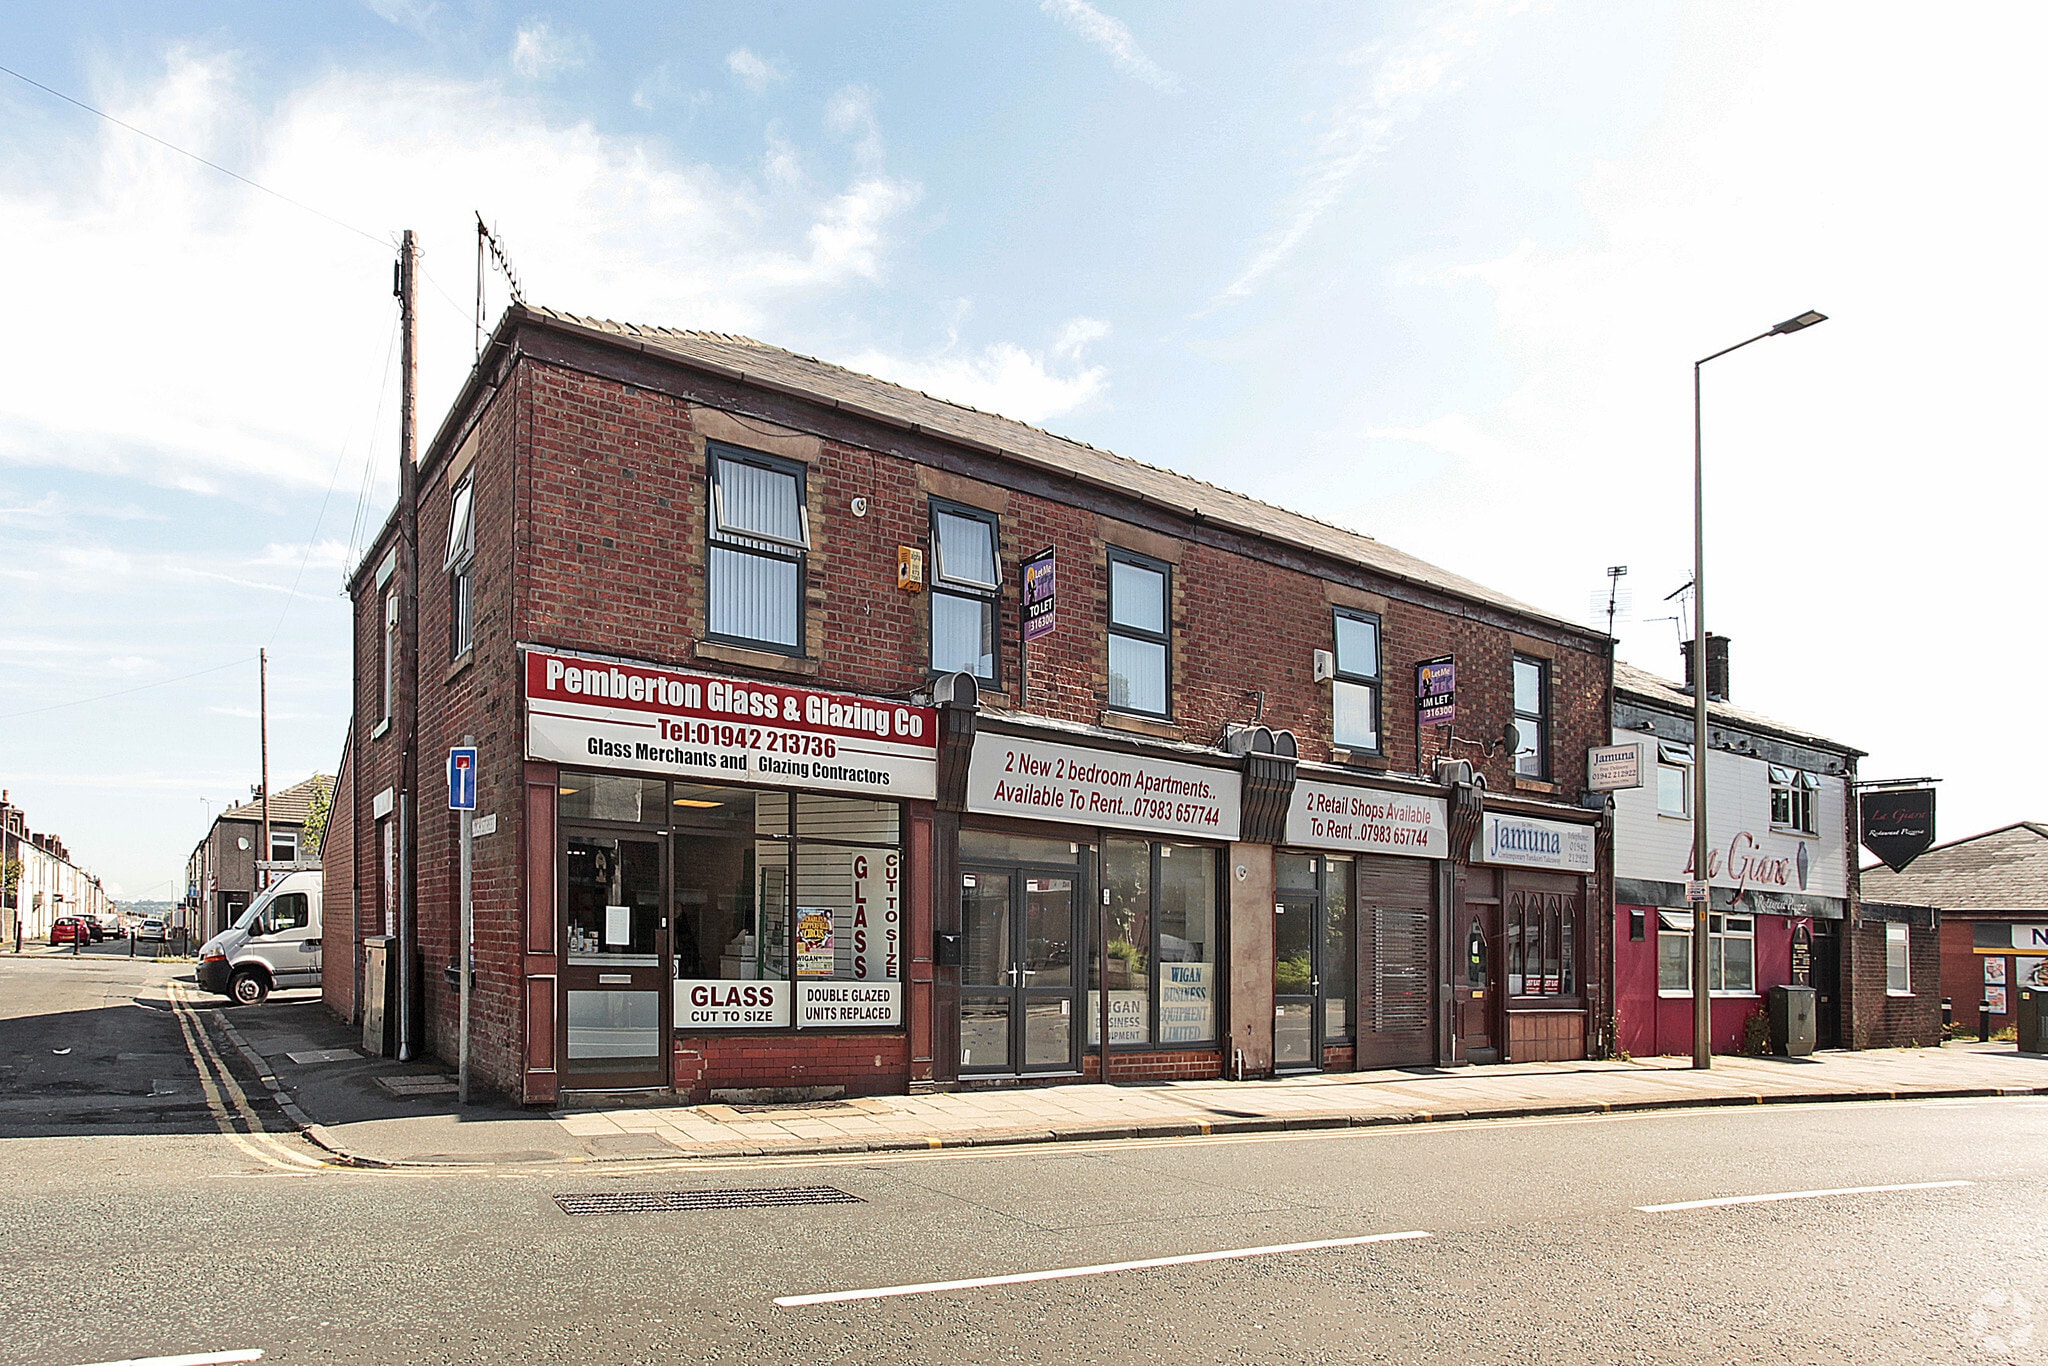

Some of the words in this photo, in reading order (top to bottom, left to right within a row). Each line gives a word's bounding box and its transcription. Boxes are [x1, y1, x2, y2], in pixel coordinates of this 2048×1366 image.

[1029, 604, 1039, 618] TO
[1040, 598, 1053, 613] LET
[1030, 614, 1053, 631] 316300
[546, 658, 702, 709] Pemberton
[707, 681, 778, 719] Glass
[783, 696, 801, 722] &
[805, 695, 890, 737] Glazing
[894, 708, 923, 738] Co
[1434, 694, 1449, 705] LET
[1426, 706, 1453, 718] 316300
[657, 718, 761, 750] Tel:01942
[766, 731, 836, 759] 213736
[587, 737, 632, 759] Glass
[635, 742, 717, 768] Merchants
[720, 754, 747, 771] and
[758, 756, 809, 779] Glazing
[812, 762, 890, 785] Contractors
[1593, 751, 1634, 766] Jamuna
[1005, 751, 1015, 772] 2
[1018, 753, 1052, 777] New
[1056, 758, 1065, 779] 2
[1068, 760, 1132, 788] bedroom
[1592, 772, 1611, 780] 01942
[1613, 770, 1636, 778] 212922
[994, 779, 1064, 808] Available
[1069, 789, 1085, 810] To
[1175, 803, 1220, 826] 657744
[1307, 792, 1314, 810] 2
[1317, 793, 1348, 815] Retail
[1351, 797, 1384, 822] Shops
[1386, 803, 1431, 824] Available
[1311, 818, 1323, 836] To
[1326, 819, 1352, 840] Rent
[1394, 827, 1428, 846] 657744
[1491, 818, 1561, 857] Jamuna
[1569, 842, 1587, 852] 01942
[1568, 853, 1588, 863] 212922
[885, 854, 897, 892] CUT
[854, 855, 867, 979] GLASS
[885, 897, 897, 922] TO
[885, 929, 897, 978] SIZE
[1171, 967, 1201, 982] WIGAN
[690, 986, 774, 1007] GLASS
[807, 988, 848, 1002] DOUBLE
[851, 989, 890, 1002] GLAZED
[1164, 986, 1206, 1002] BUSINESS
[691, 1011, 718, 1022] CUT
[722, 1011, 740, 1022] TO
[744, 1011, 773, 1022] SIZE
[805, 1007, 837, 1020] UNITS
[840, 1007, 891, 1020] REPLACED
[1096, 1017, 1140, 1028] BSINESS
[1163, 1026, 1200, 1041] LIMITED
